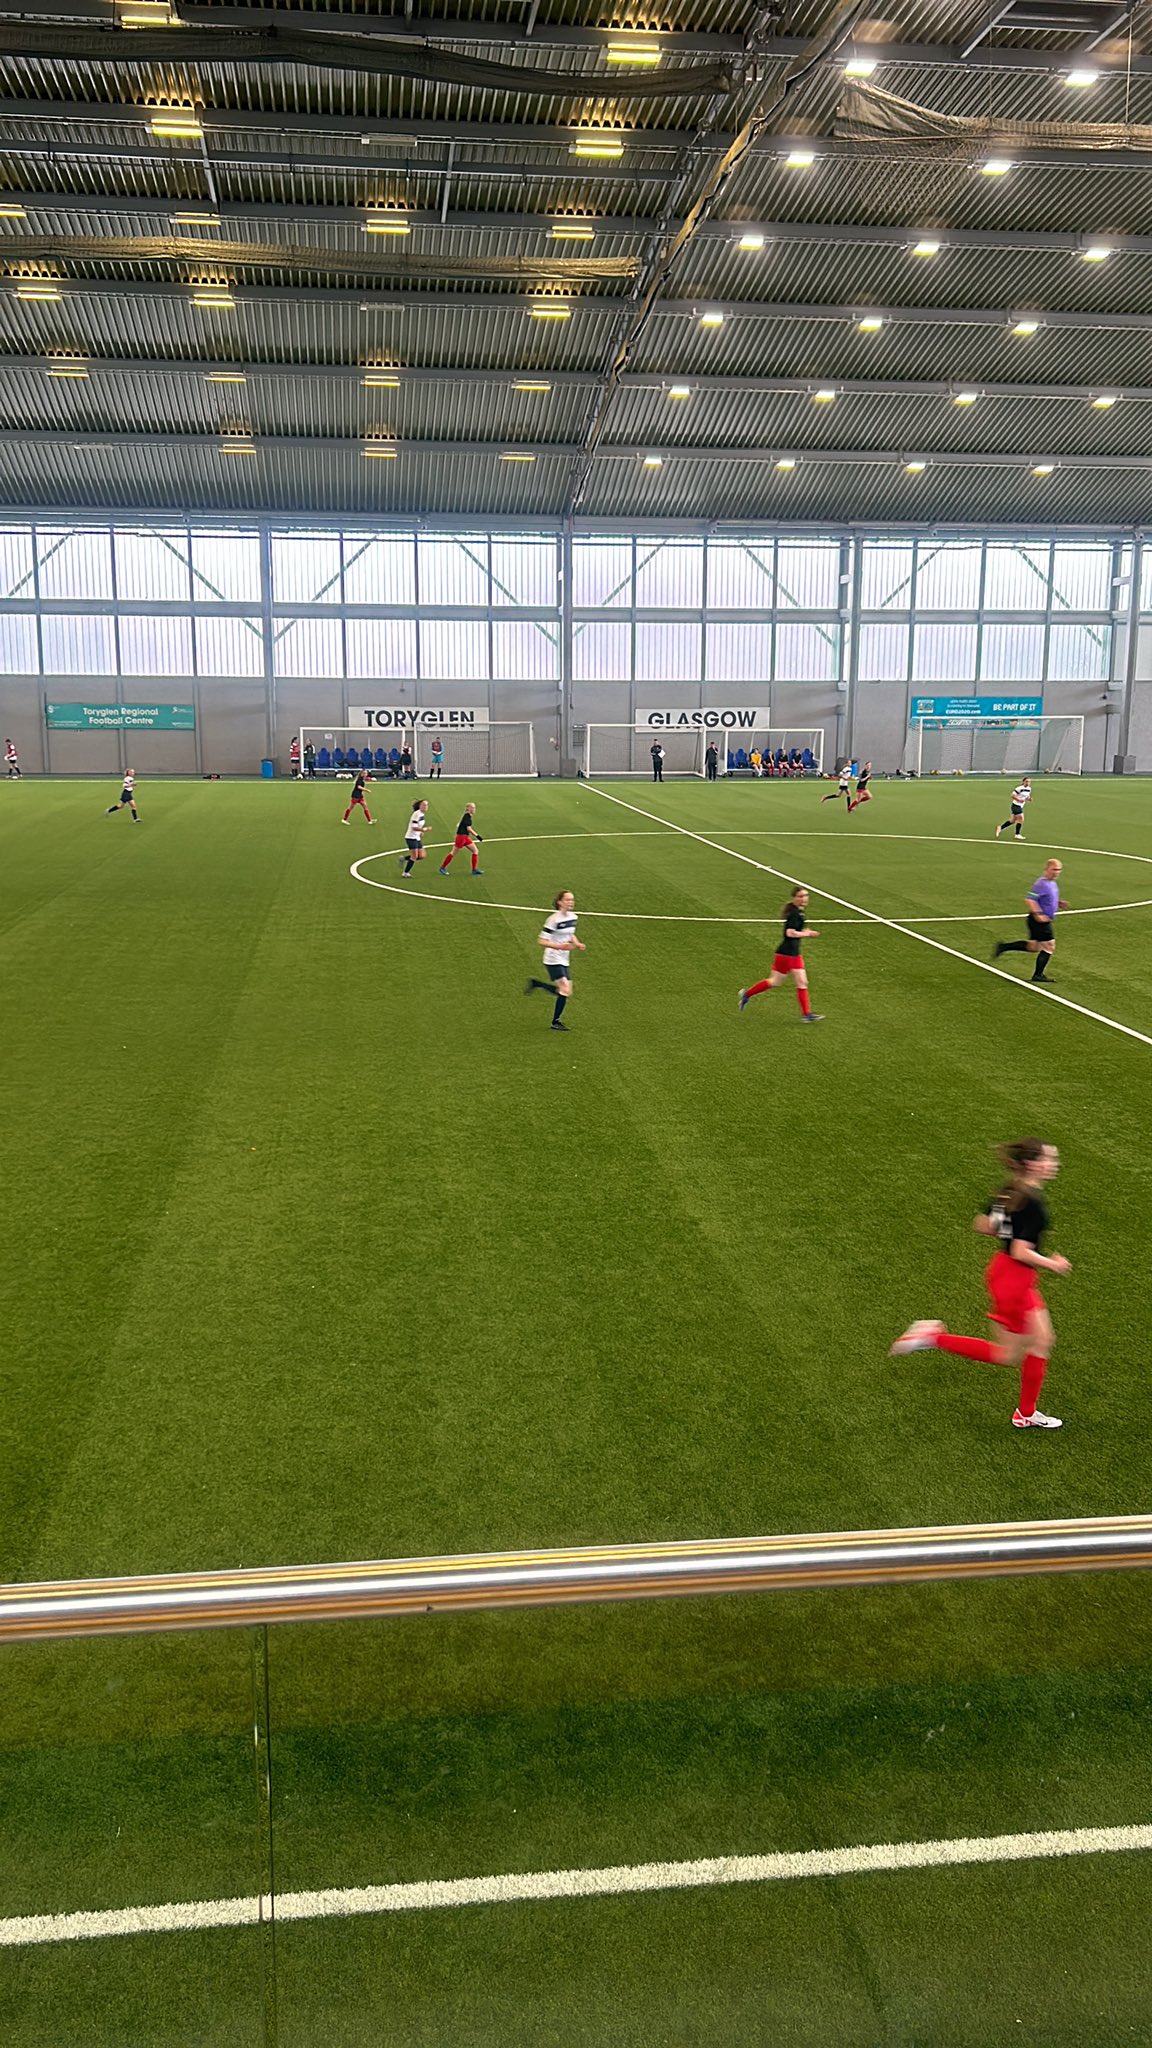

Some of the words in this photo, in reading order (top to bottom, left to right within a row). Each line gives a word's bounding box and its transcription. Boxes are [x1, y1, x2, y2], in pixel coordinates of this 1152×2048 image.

[82, 707, 119, 717] Toryglen
[121, 707, 159, 717] Regional
[993, 703, 1003, 711] BE
[1003, 703, 1019, 711] PART
[1020, 703, 1028, 711] OF
[1029, 703, 1037, 711] IT
[89, 717, 123, 725] Football
[125, 717, 154, 725] Centre
[364, 710, 474, 727] TORYGLEN
[648, 711, 757, 729] GLASGOW
